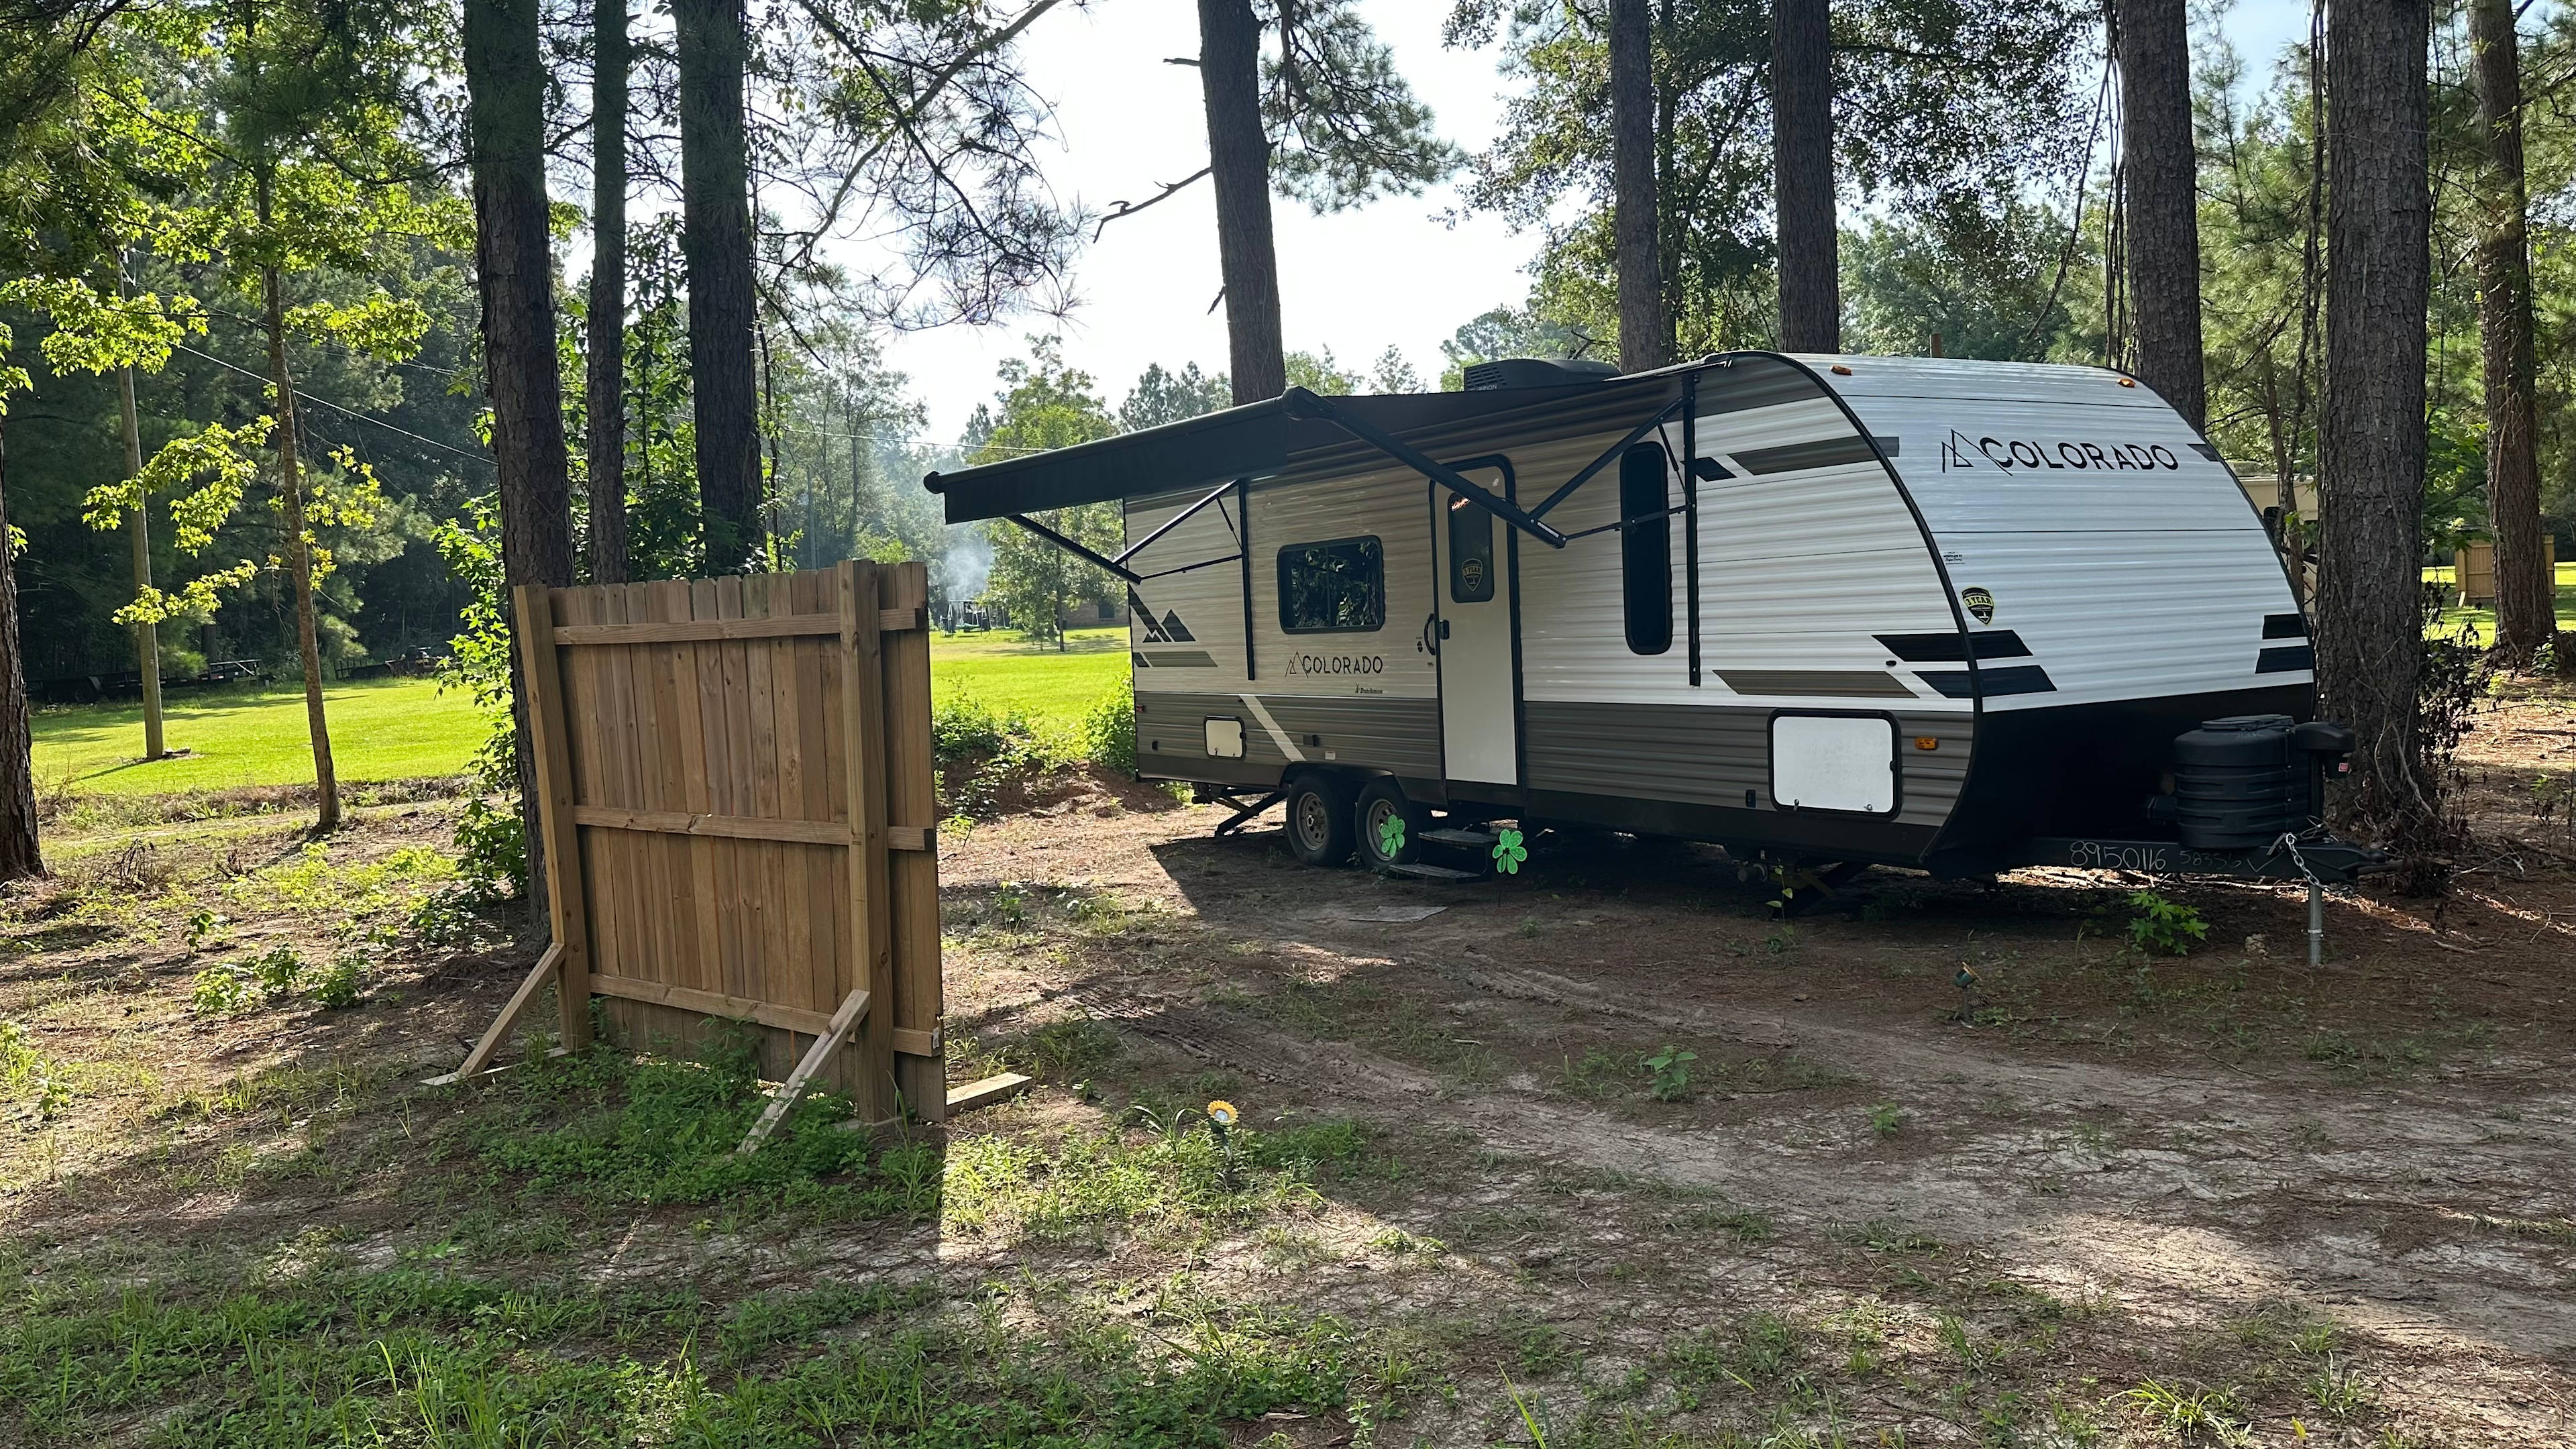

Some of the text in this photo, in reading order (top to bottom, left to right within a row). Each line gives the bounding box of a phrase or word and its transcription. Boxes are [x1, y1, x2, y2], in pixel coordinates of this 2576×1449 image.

[1980, 437, 2179, 470] COLORADO
[1972, 596, 1992, 604] YEAR
[1302, 655, 1383, 674] COLORADO
[2069, 840, 2167, 871] 8950116
